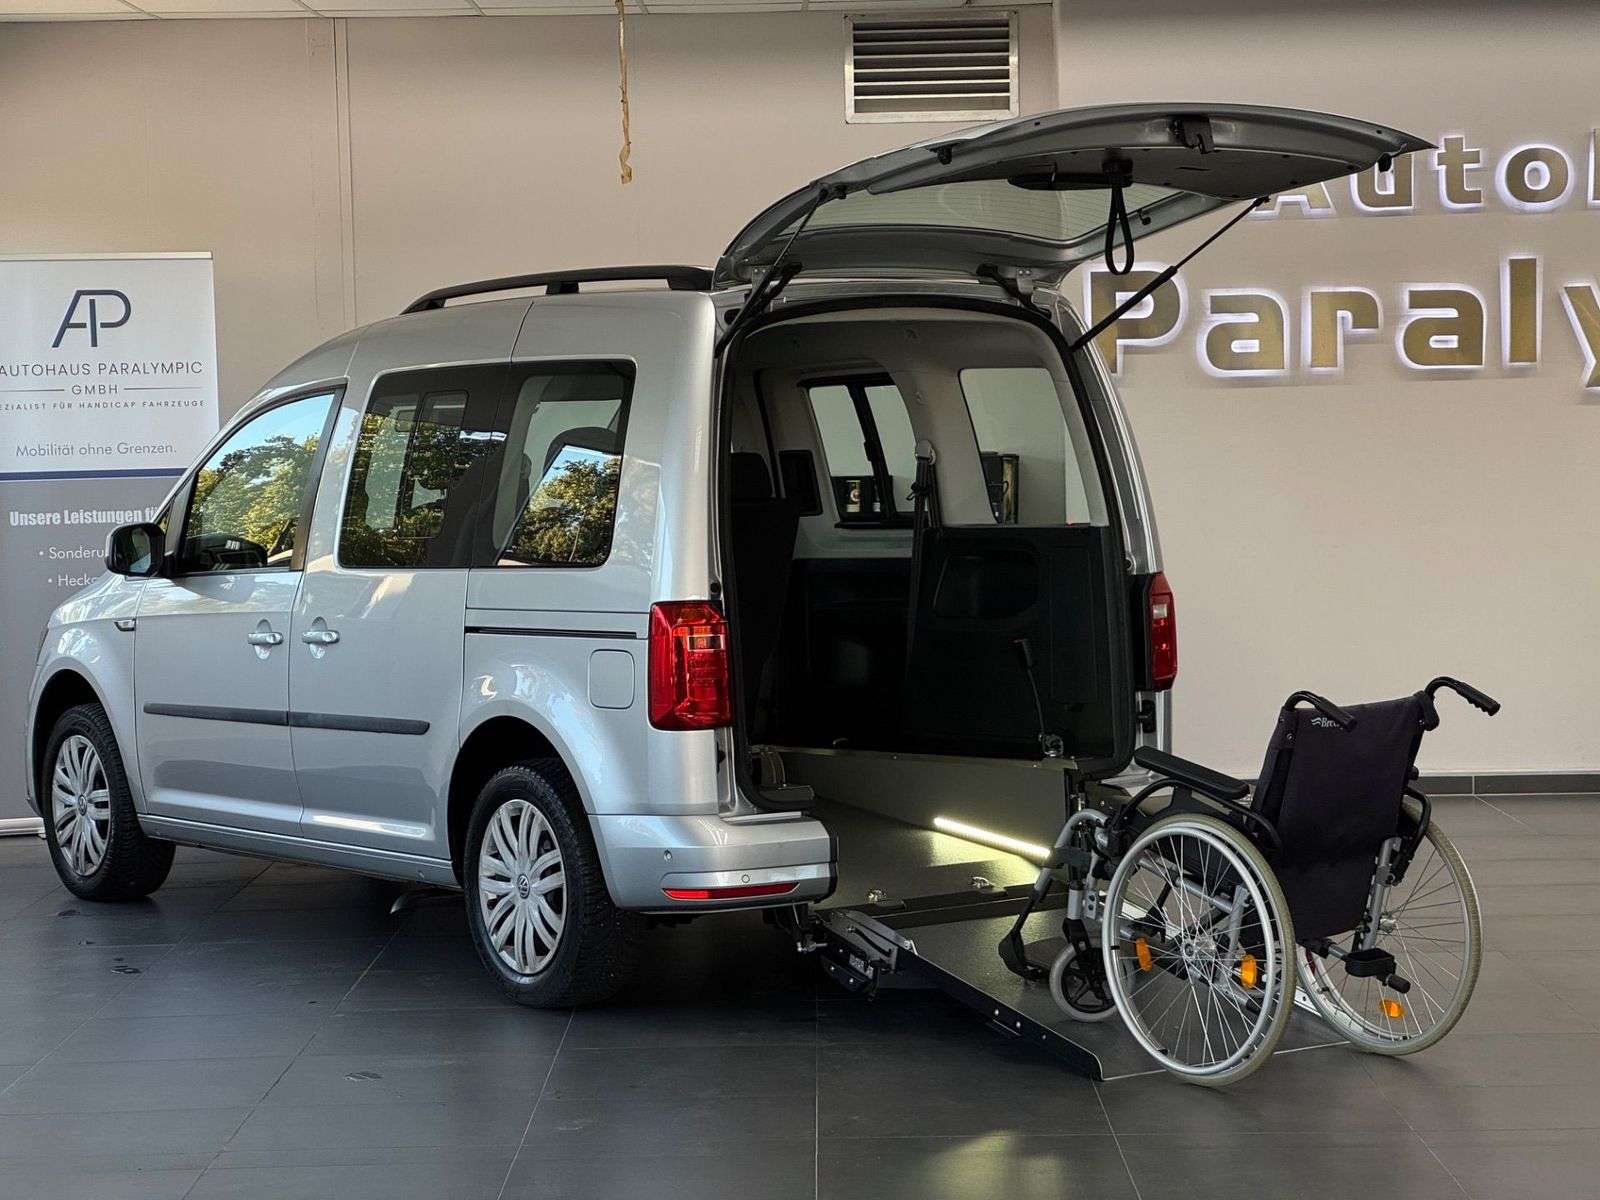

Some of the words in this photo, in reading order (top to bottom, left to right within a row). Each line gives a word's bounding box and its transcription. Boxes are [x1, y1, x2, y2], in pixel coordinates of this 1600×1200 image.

[51, 289, 132, 348] AP
[0, 362, 91, 377] AUTOHAUS
[98, 361, 204, 375] PARALYMPIC
[71, 384, 119, 395] GMBH
[52, 400, 74, 409] FÜR
[79, 400, 137, 409] HANDICAP
[142, 399, 205, 408] FAHRZEUGE
[16, 443, 75, 457] Mobilität
[78, 442, 113, 456] ohne
[116, 441, 177, 456] Grenzen.
[9, 510, 61, 526] Unsere
[63, 508, 143, 526] Leistungen
